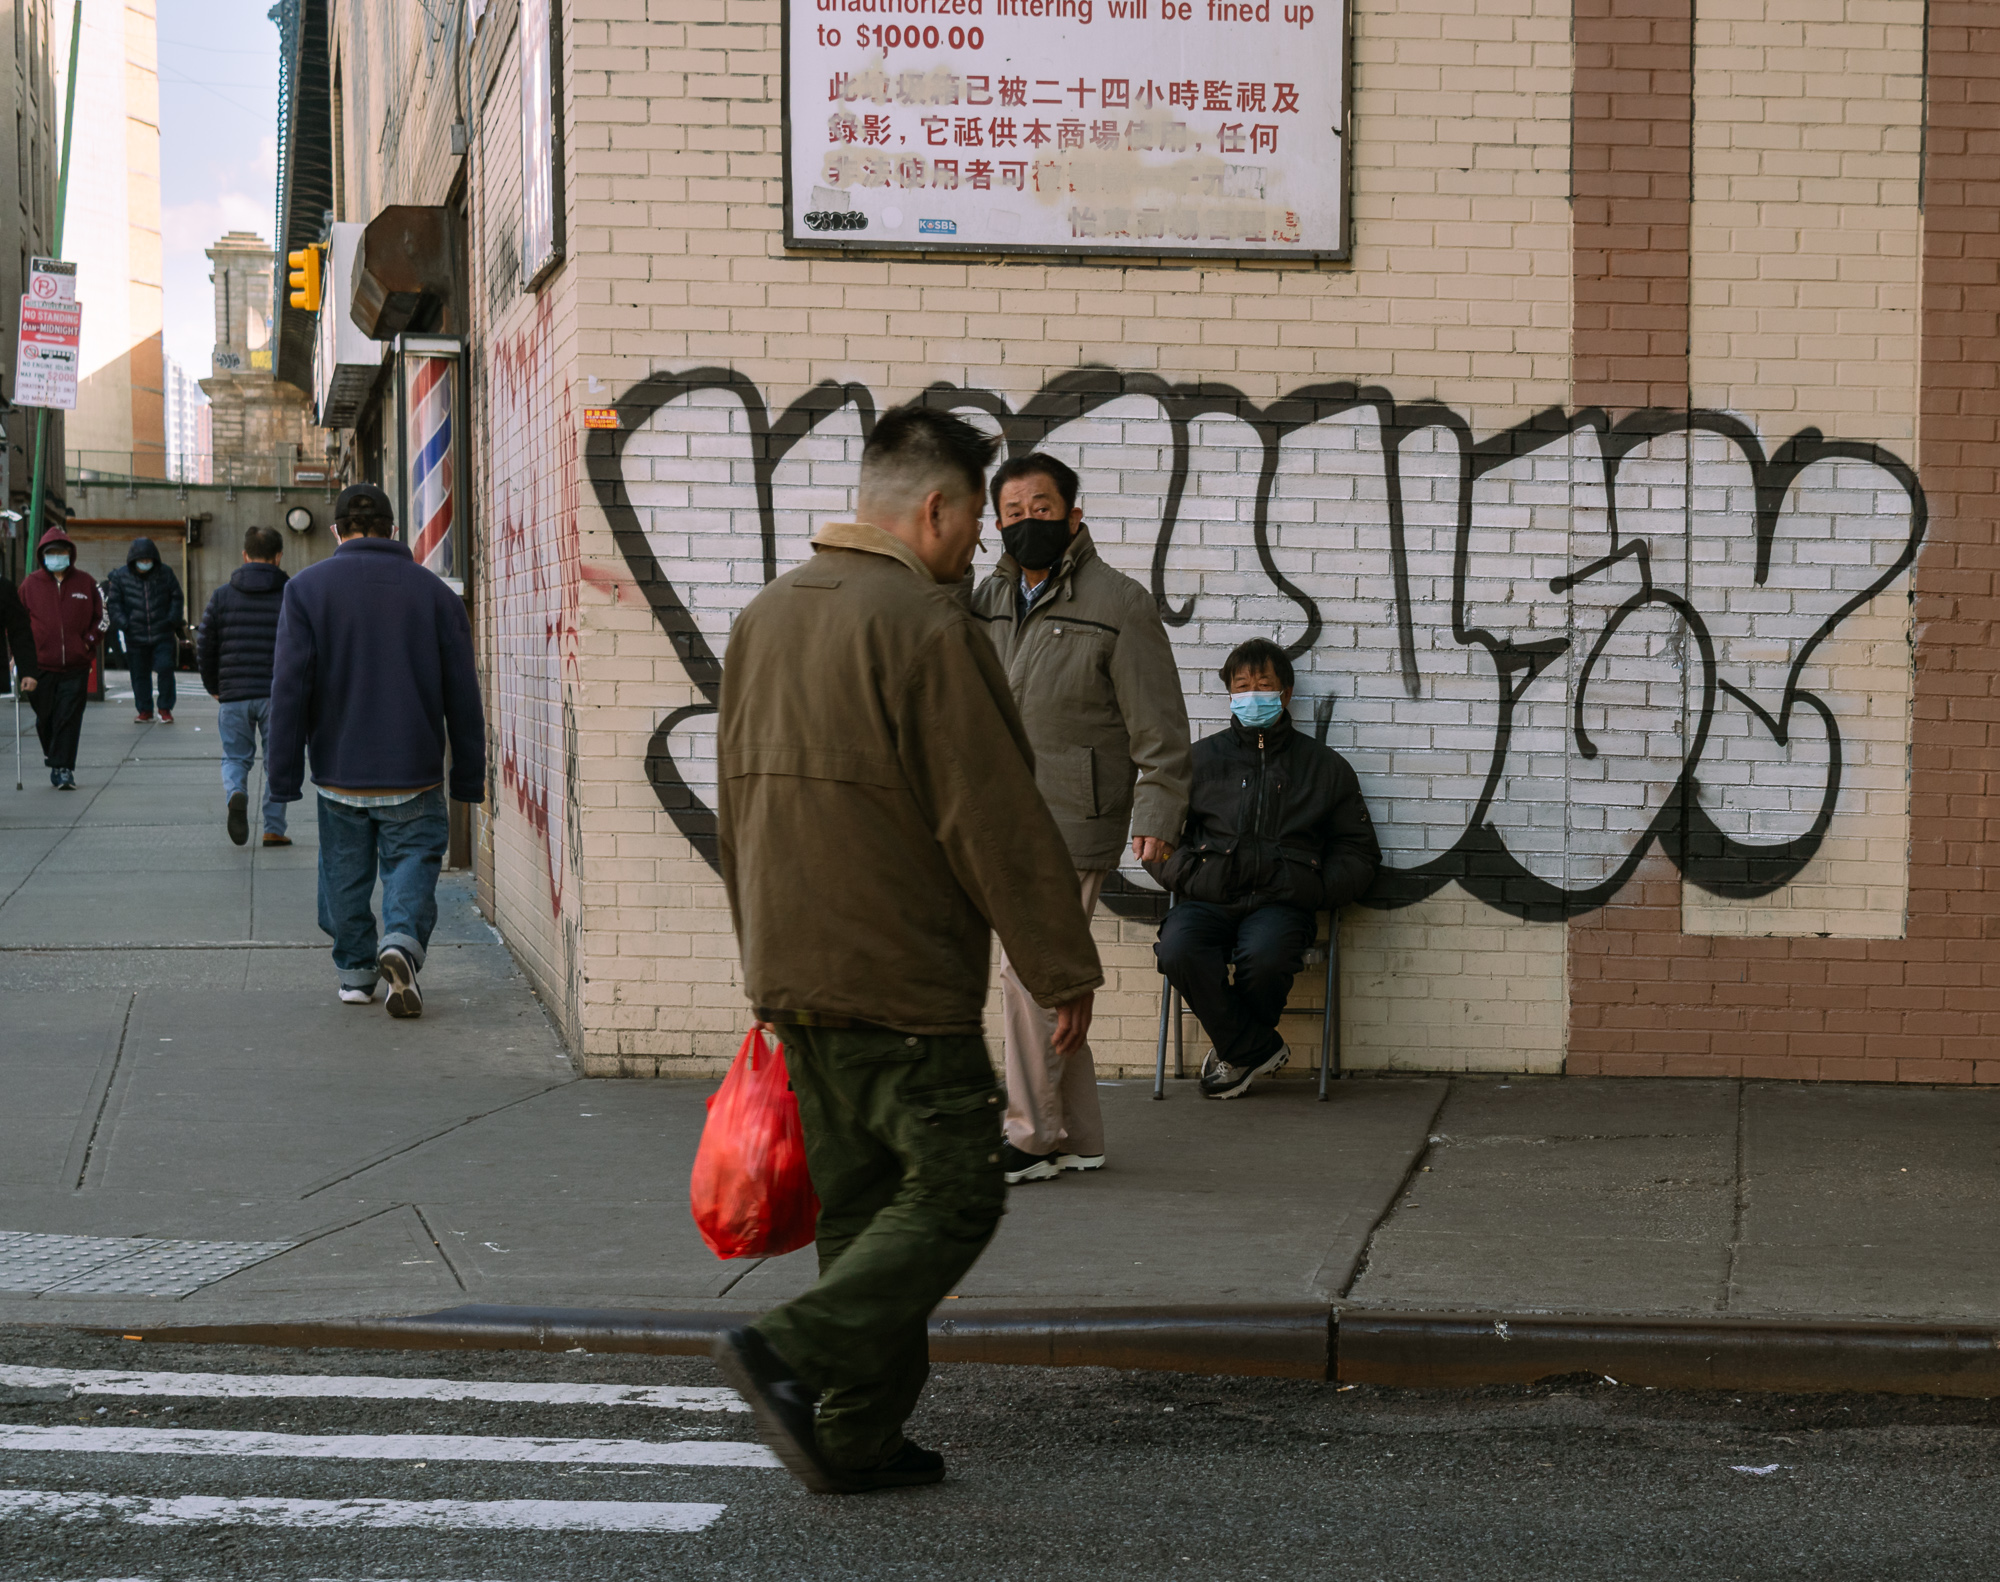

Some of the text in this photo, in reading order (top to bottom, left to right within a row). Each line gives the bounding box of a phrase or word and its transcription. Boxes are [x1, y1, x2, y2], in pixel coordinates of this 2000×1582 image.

[816, 0, 1314, 30] unauthorized littering will be fined up
[817, 23, 842, 47] to
[24, 309, 79, 324] NO STANDING
[32, 361, 52, 369] ENGINE
[55, 364, 74, 372] IDLING
[47, 370, 76, 382] $2000
